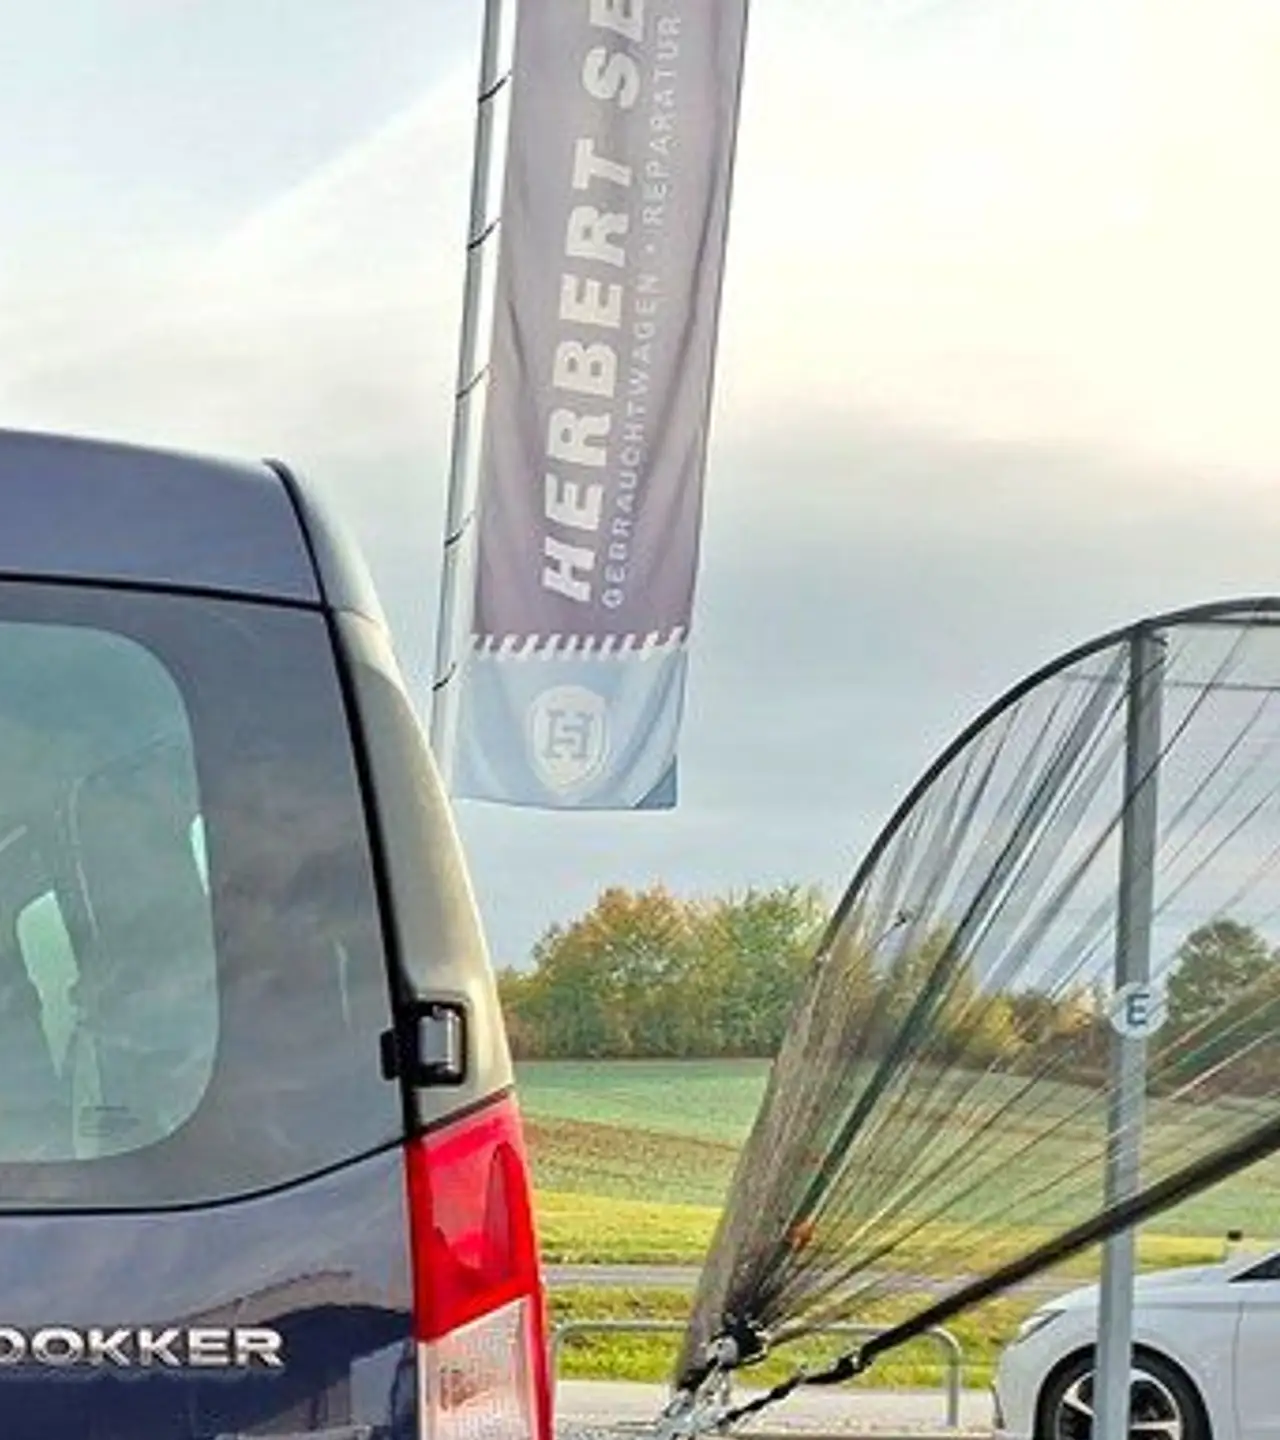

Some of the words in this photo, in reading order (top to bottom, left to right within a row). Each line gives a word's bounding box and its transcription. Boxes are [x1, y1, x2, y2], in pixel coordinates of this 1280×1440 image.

[542, 136, 634, 603] HERBERT
[600, 273, 660, 609] GEBRAUCHTWAGEN
[641, 16, 682, 227] REPARATUR
[1126, 993, 1151, 1026] E
